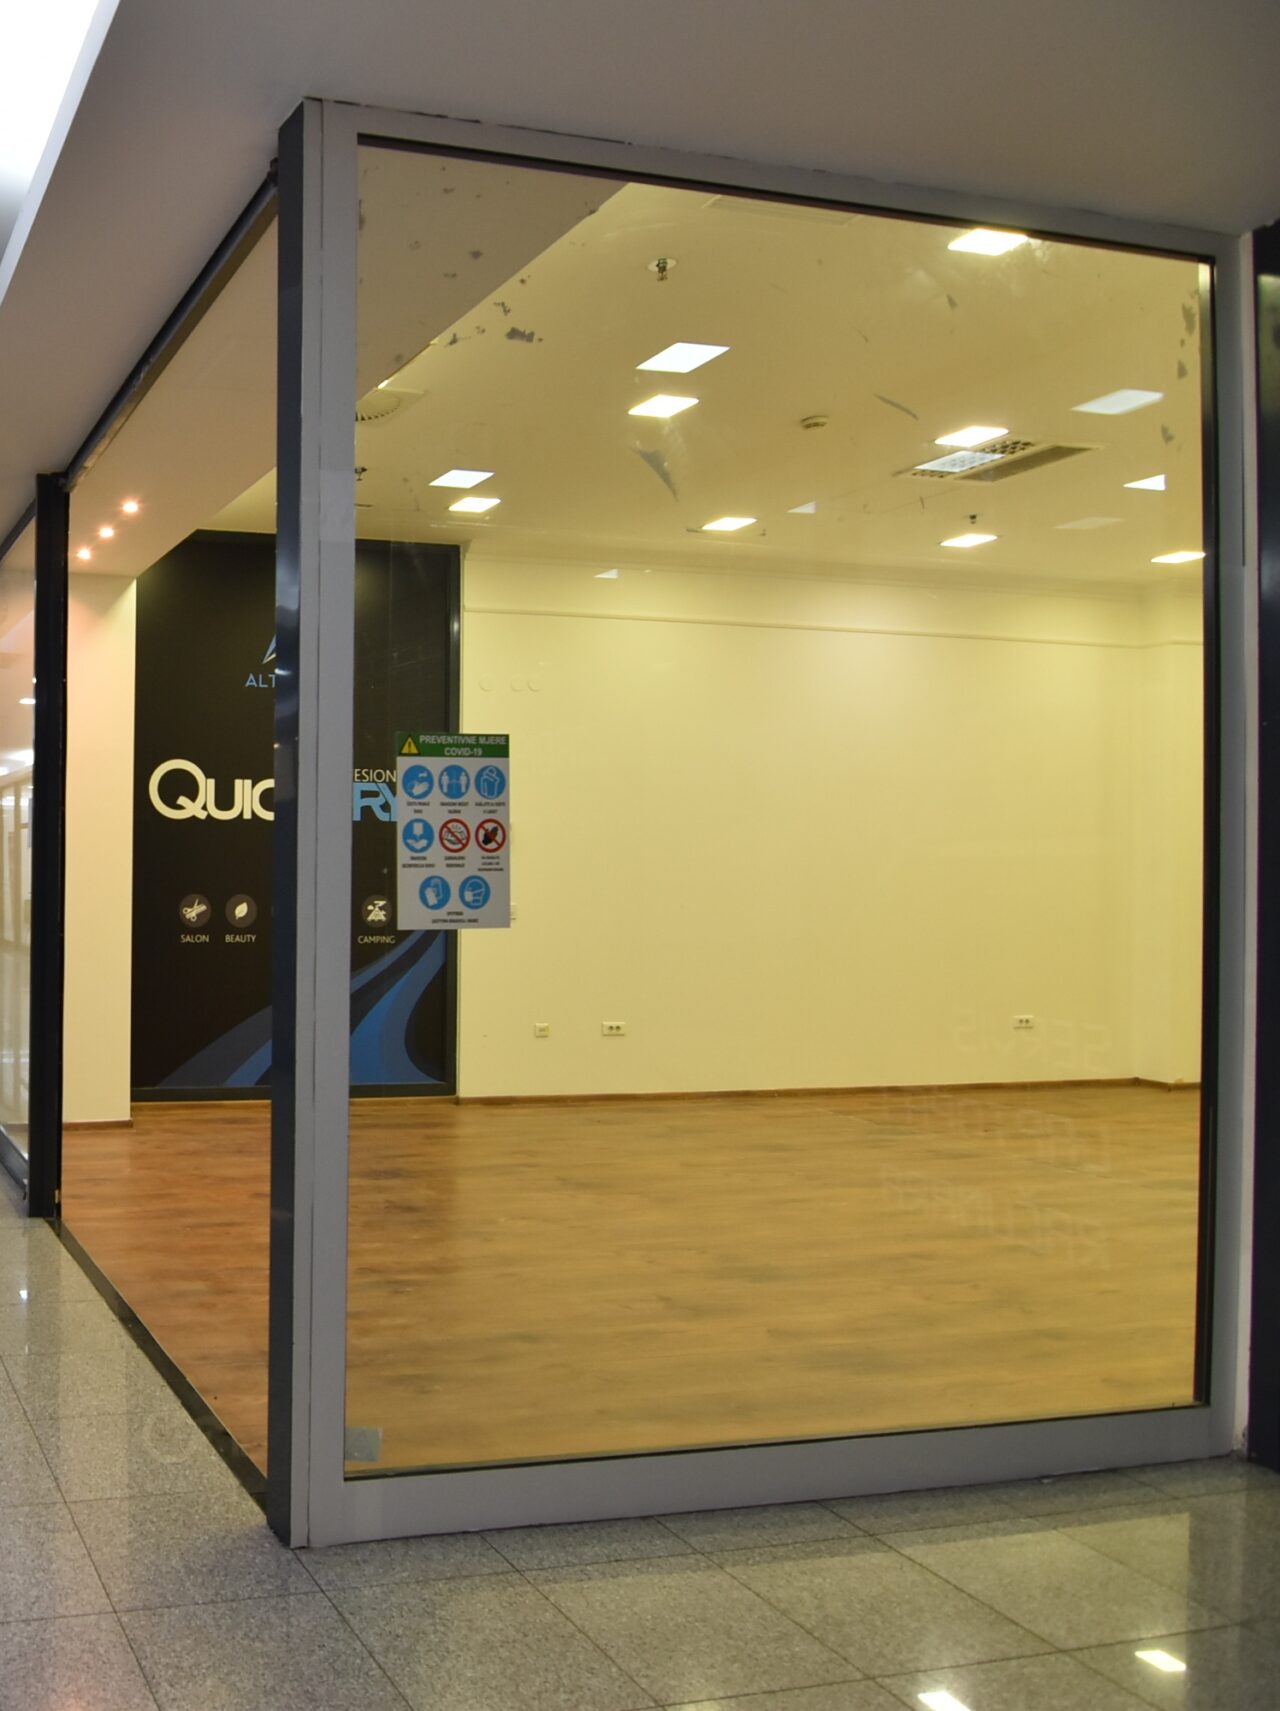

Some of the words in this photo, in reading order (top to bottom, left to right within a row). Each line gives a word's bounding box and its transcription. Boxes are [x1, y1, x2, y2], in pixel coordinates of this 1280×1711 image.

[419, 735, 477, 745] PREVENTIVNE
[479, 735, 507, 745] MJERE
[444, 747, 483, 756] COVID-19
[180, 934, 209, 943] SALON
[225, 934, 256, 943] BEAUTY
[358, 935, 396, 944] CAMPING
